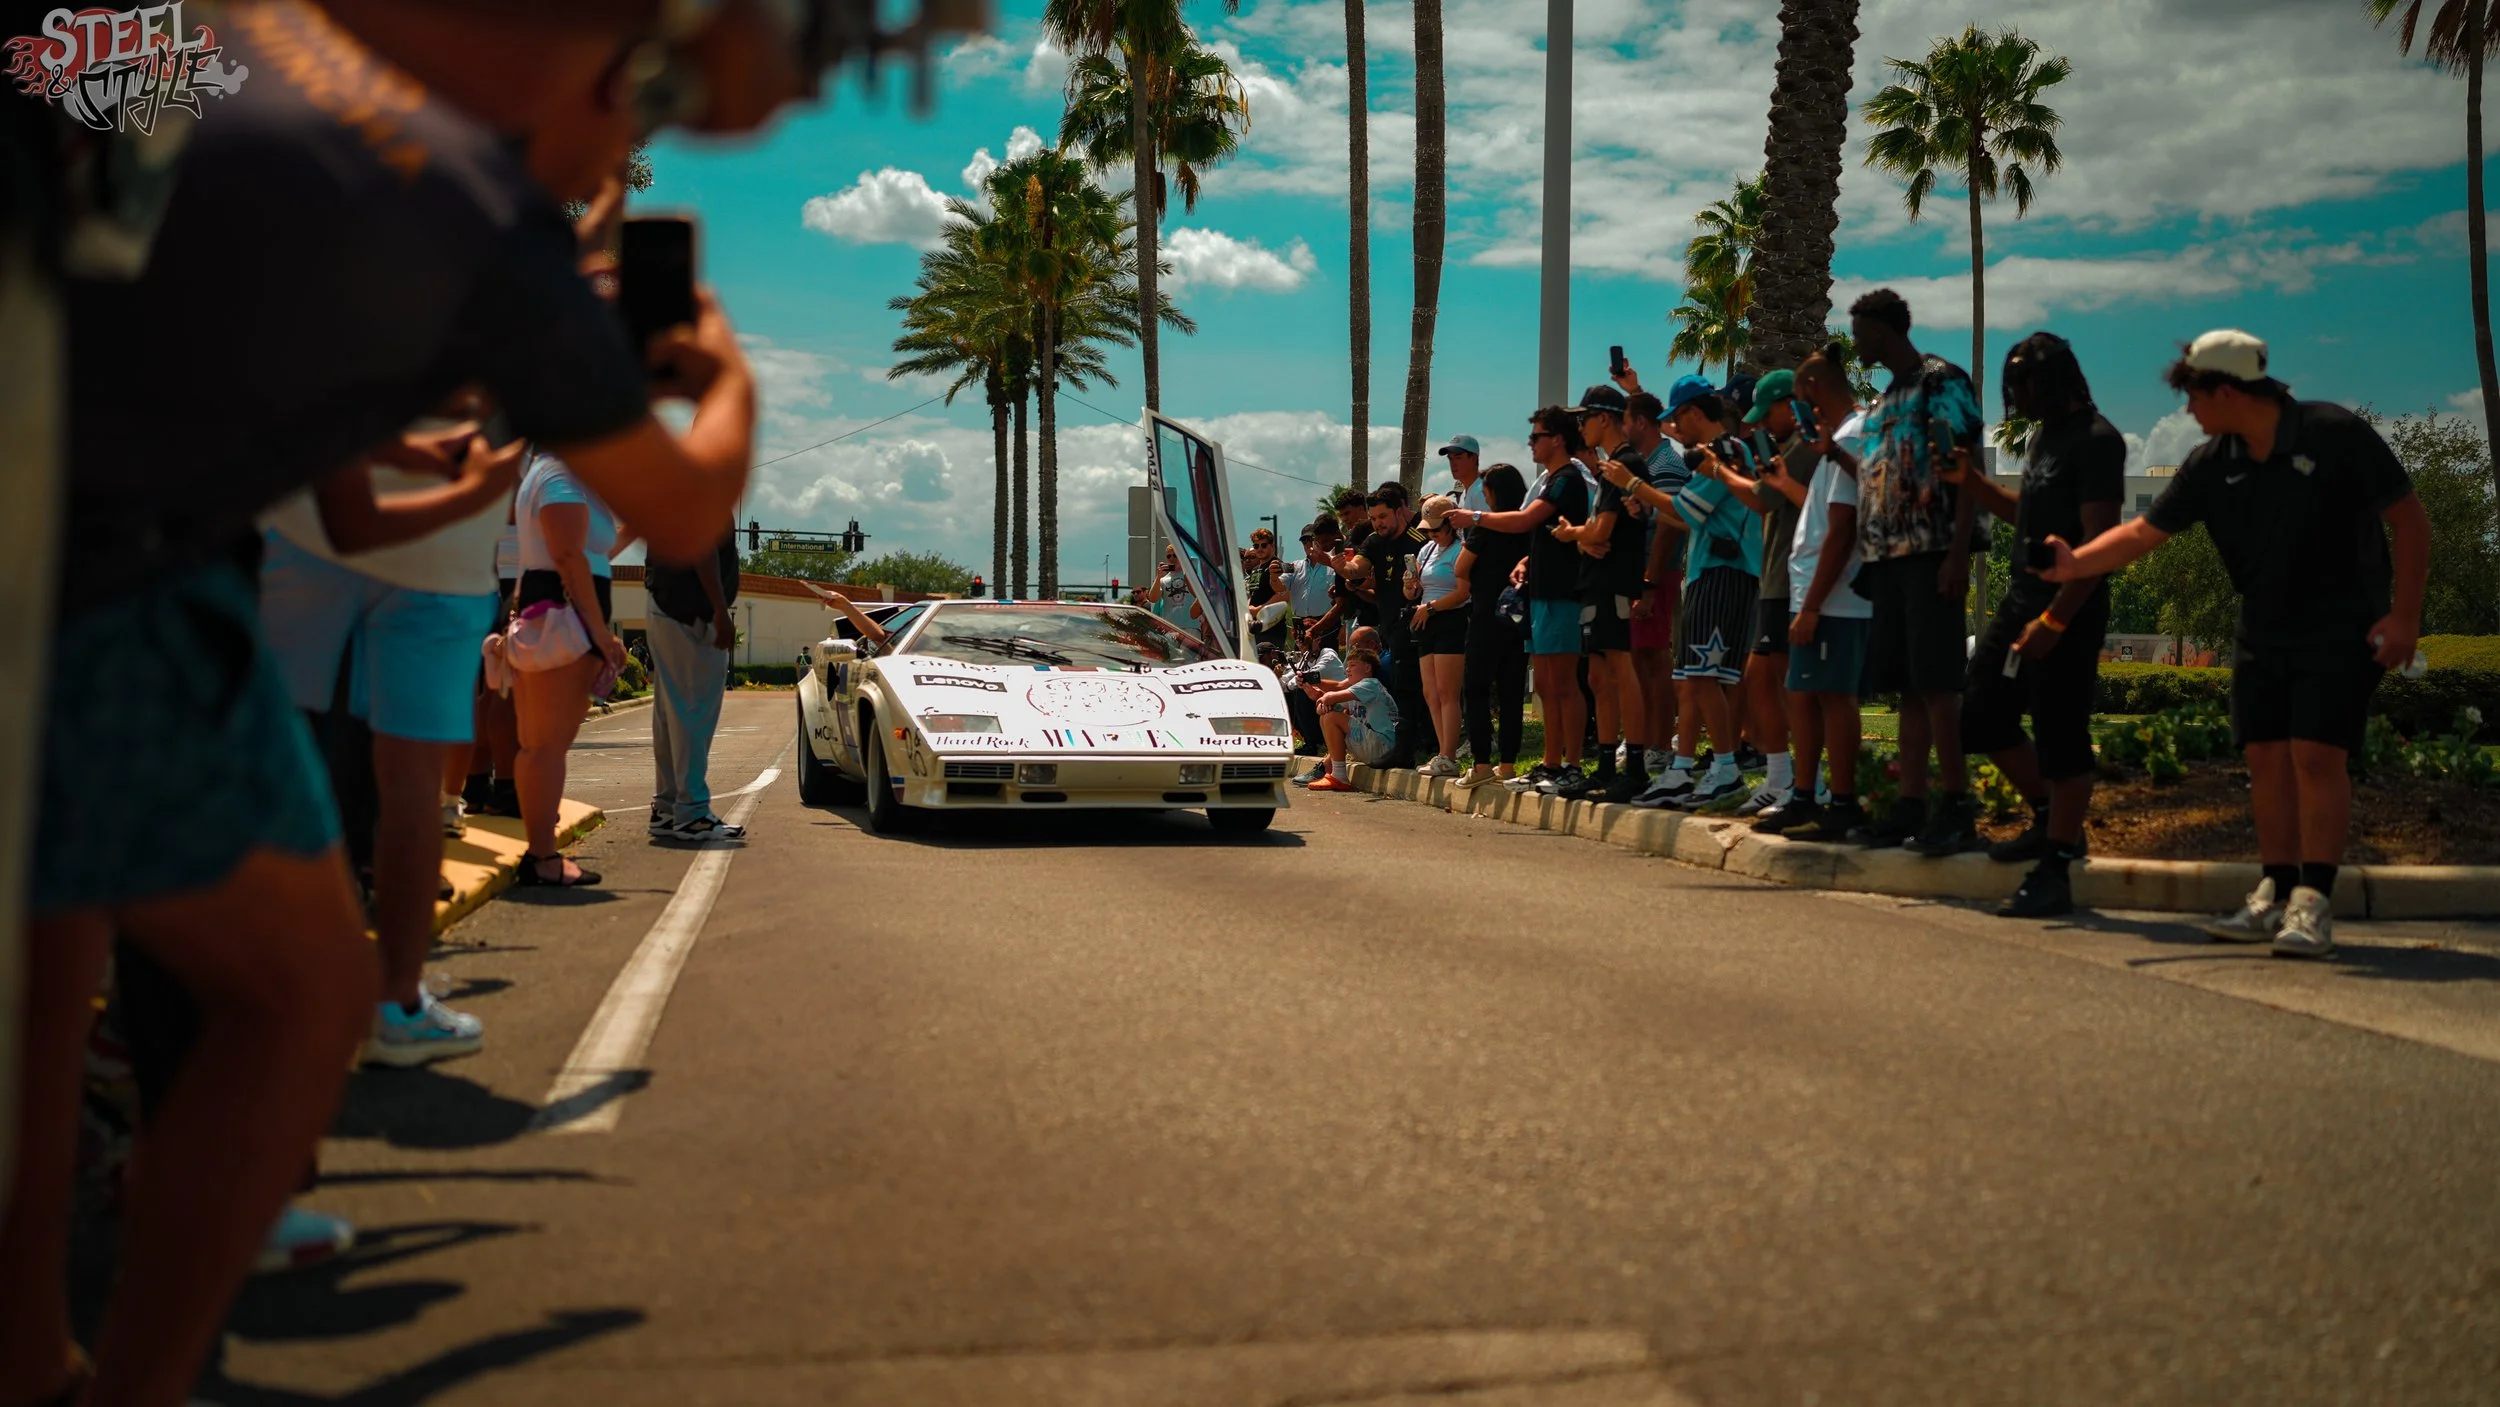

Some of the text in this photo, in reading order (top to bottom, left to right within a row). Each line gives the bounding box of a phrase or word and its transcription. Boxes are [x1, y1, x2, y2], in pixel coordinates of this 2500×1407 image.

[780, 542, 825, 551] International
[920, 675, 1000, 692] Lenovo
[1177, 679, 1254, 694] Lenovo
[936, 736, 982, 746] Hard
[1199, 737, 1288, 749] Hard Rock
